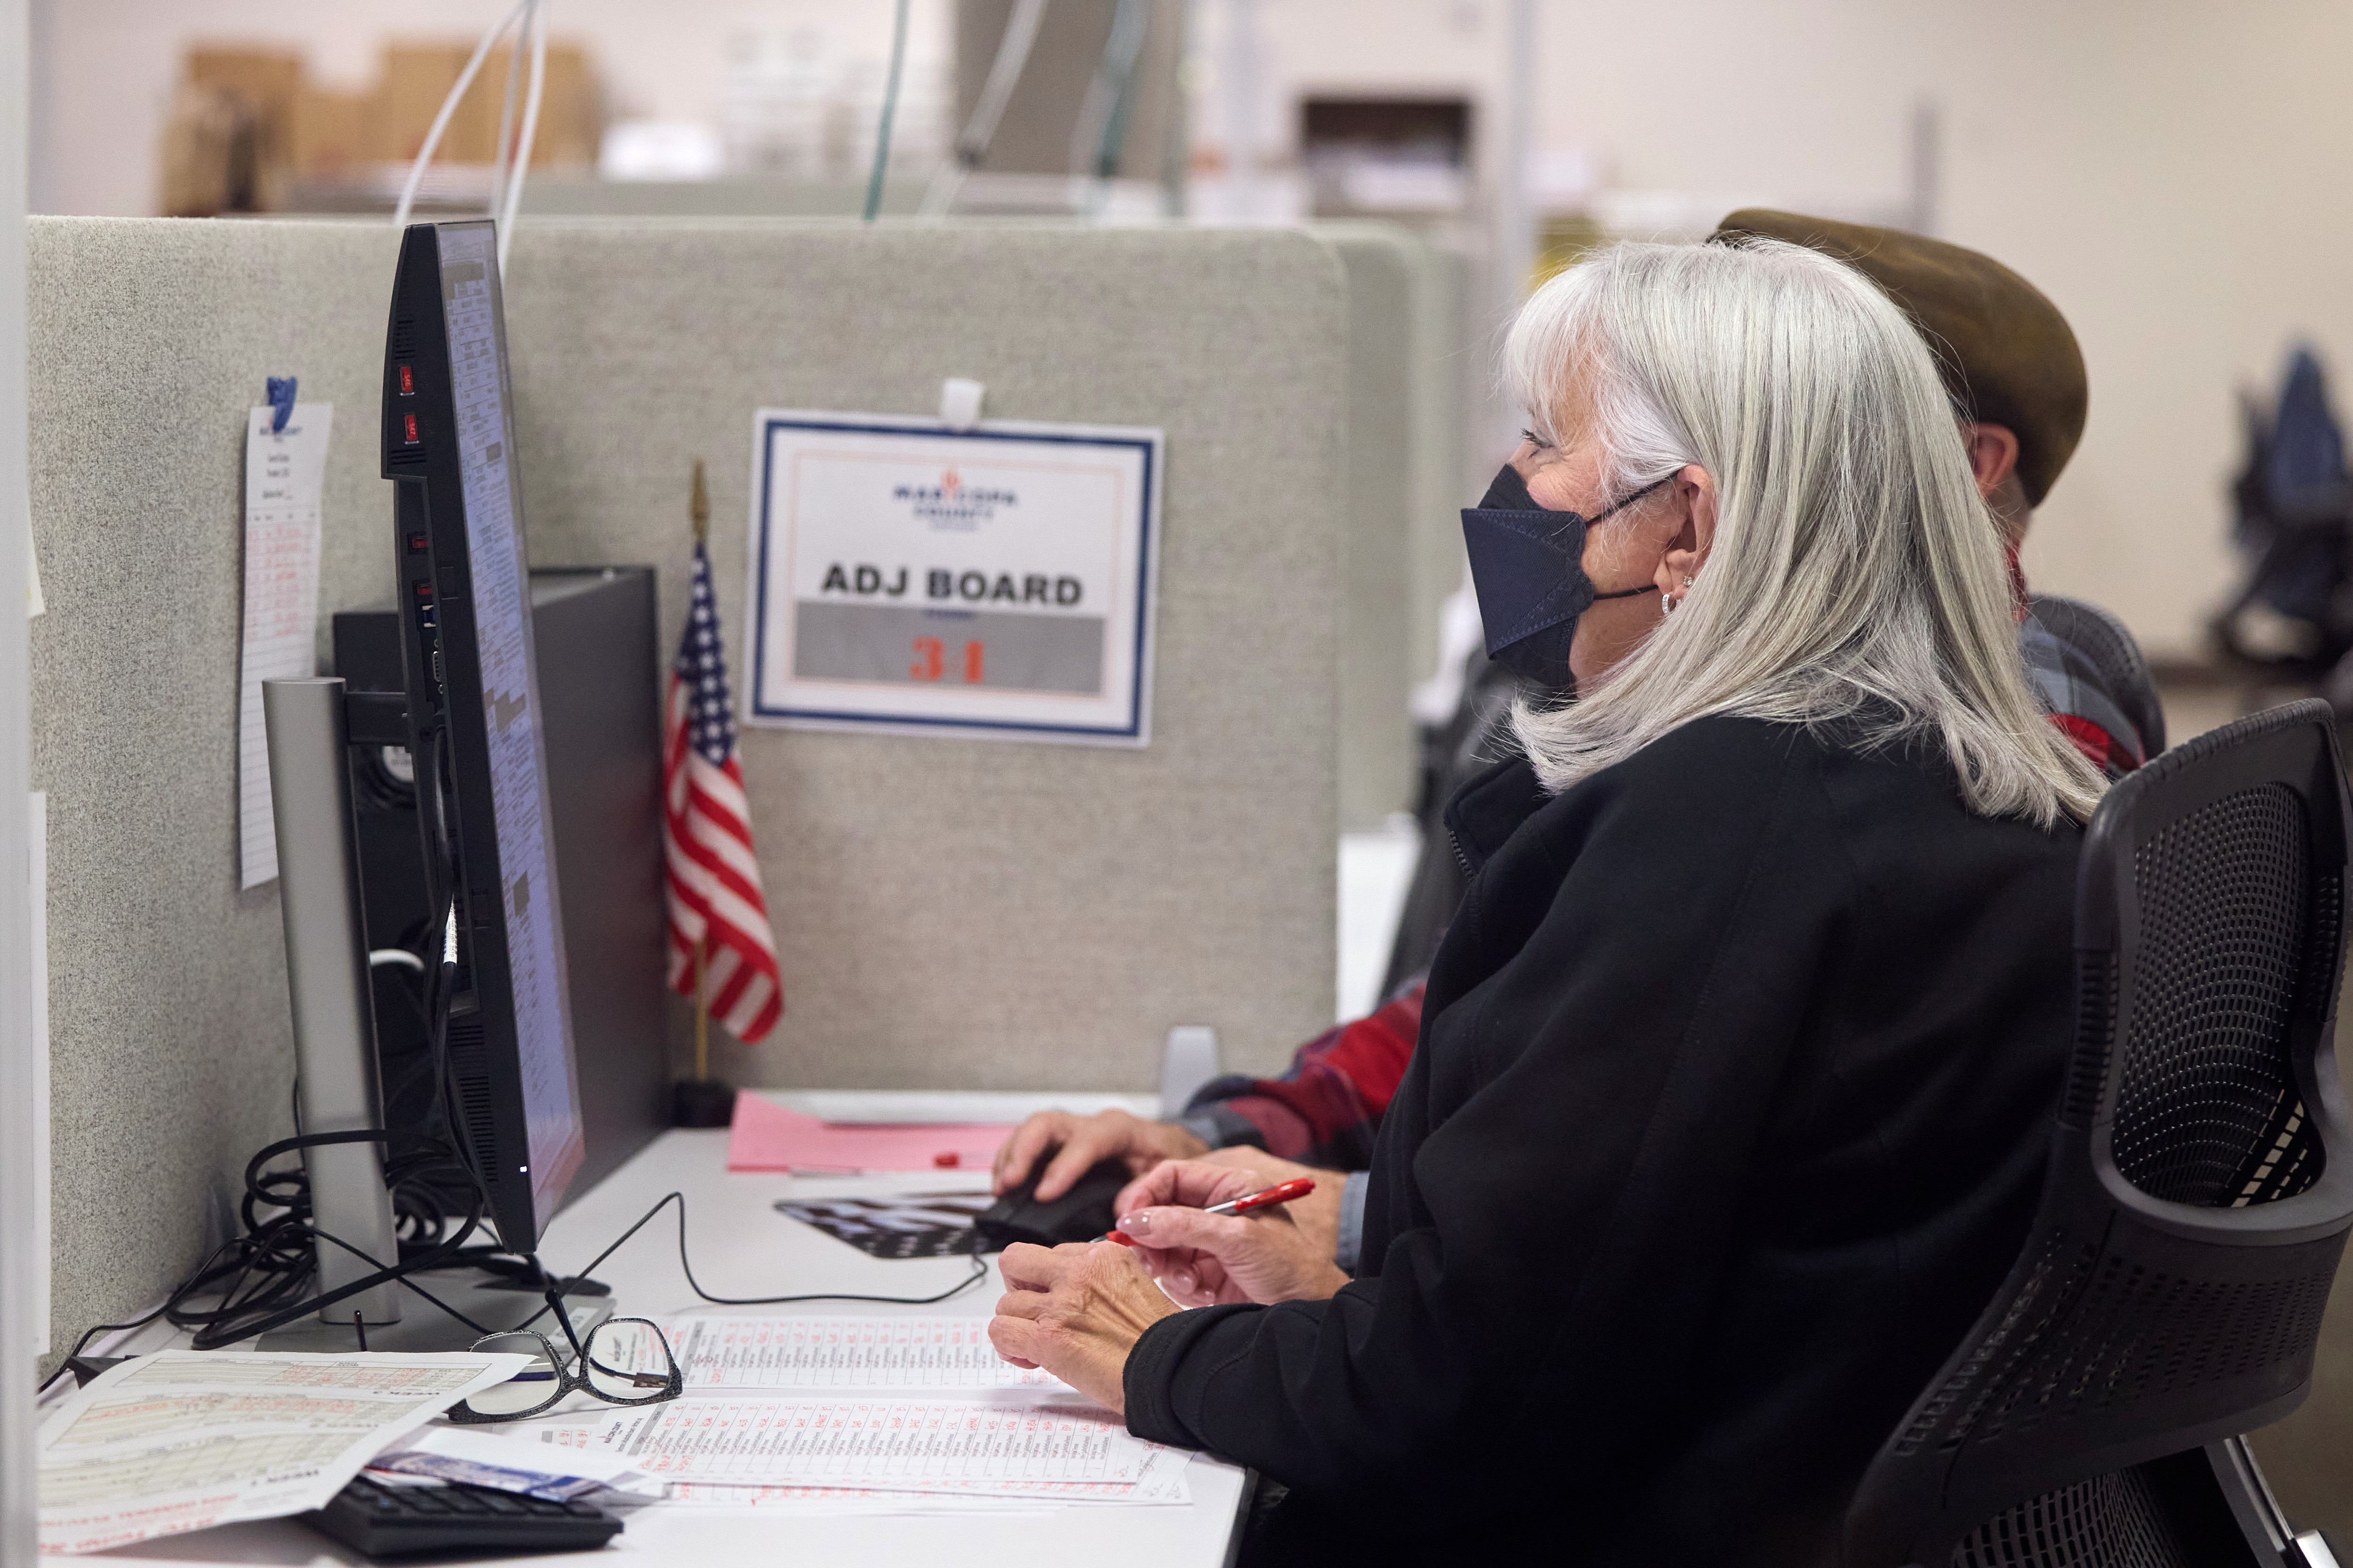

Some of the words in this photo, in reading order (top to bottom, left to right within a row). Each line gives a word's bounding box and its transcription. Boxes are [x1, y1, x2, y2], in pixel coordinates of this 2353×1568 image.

[820, 561, 910, 597] ADJ
[927, 567, 1083, 607] BOARD
[910, 634, 985, 685] 31
